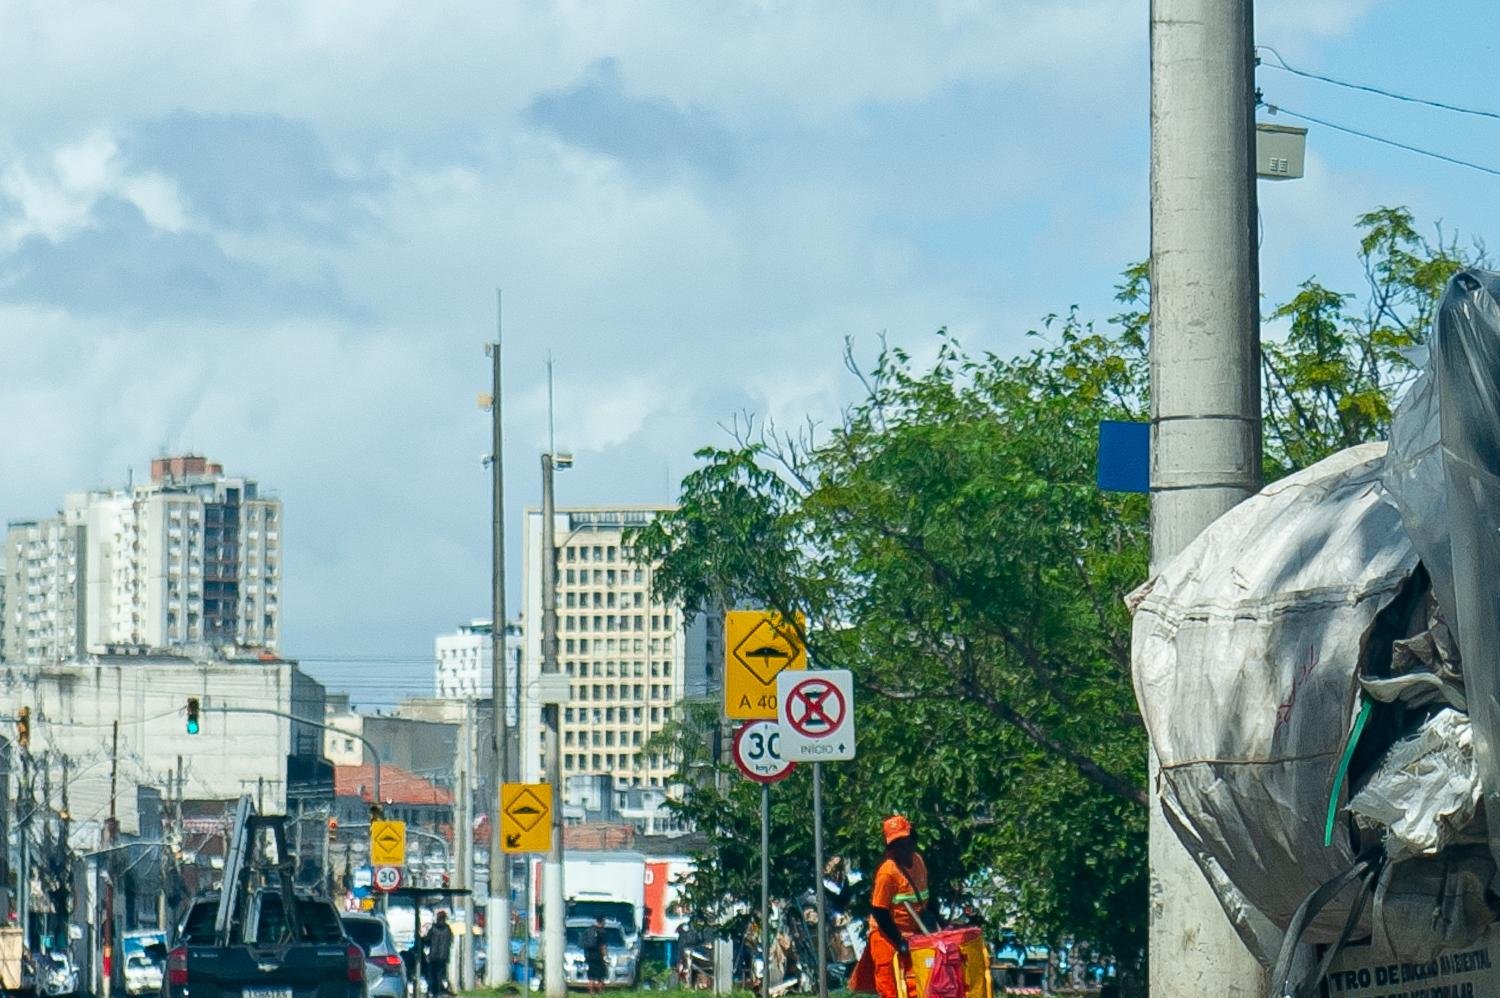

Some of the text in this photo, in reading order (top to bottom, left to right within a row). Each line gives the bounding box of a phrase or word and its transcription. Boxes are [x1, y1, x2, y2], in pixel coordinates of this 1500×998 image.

[738, 694, 752, 709] A
[748, 732, 780, 760] 30
[378, 870, 396, 883] 30
[1375, 964, 1400, 986] DE
